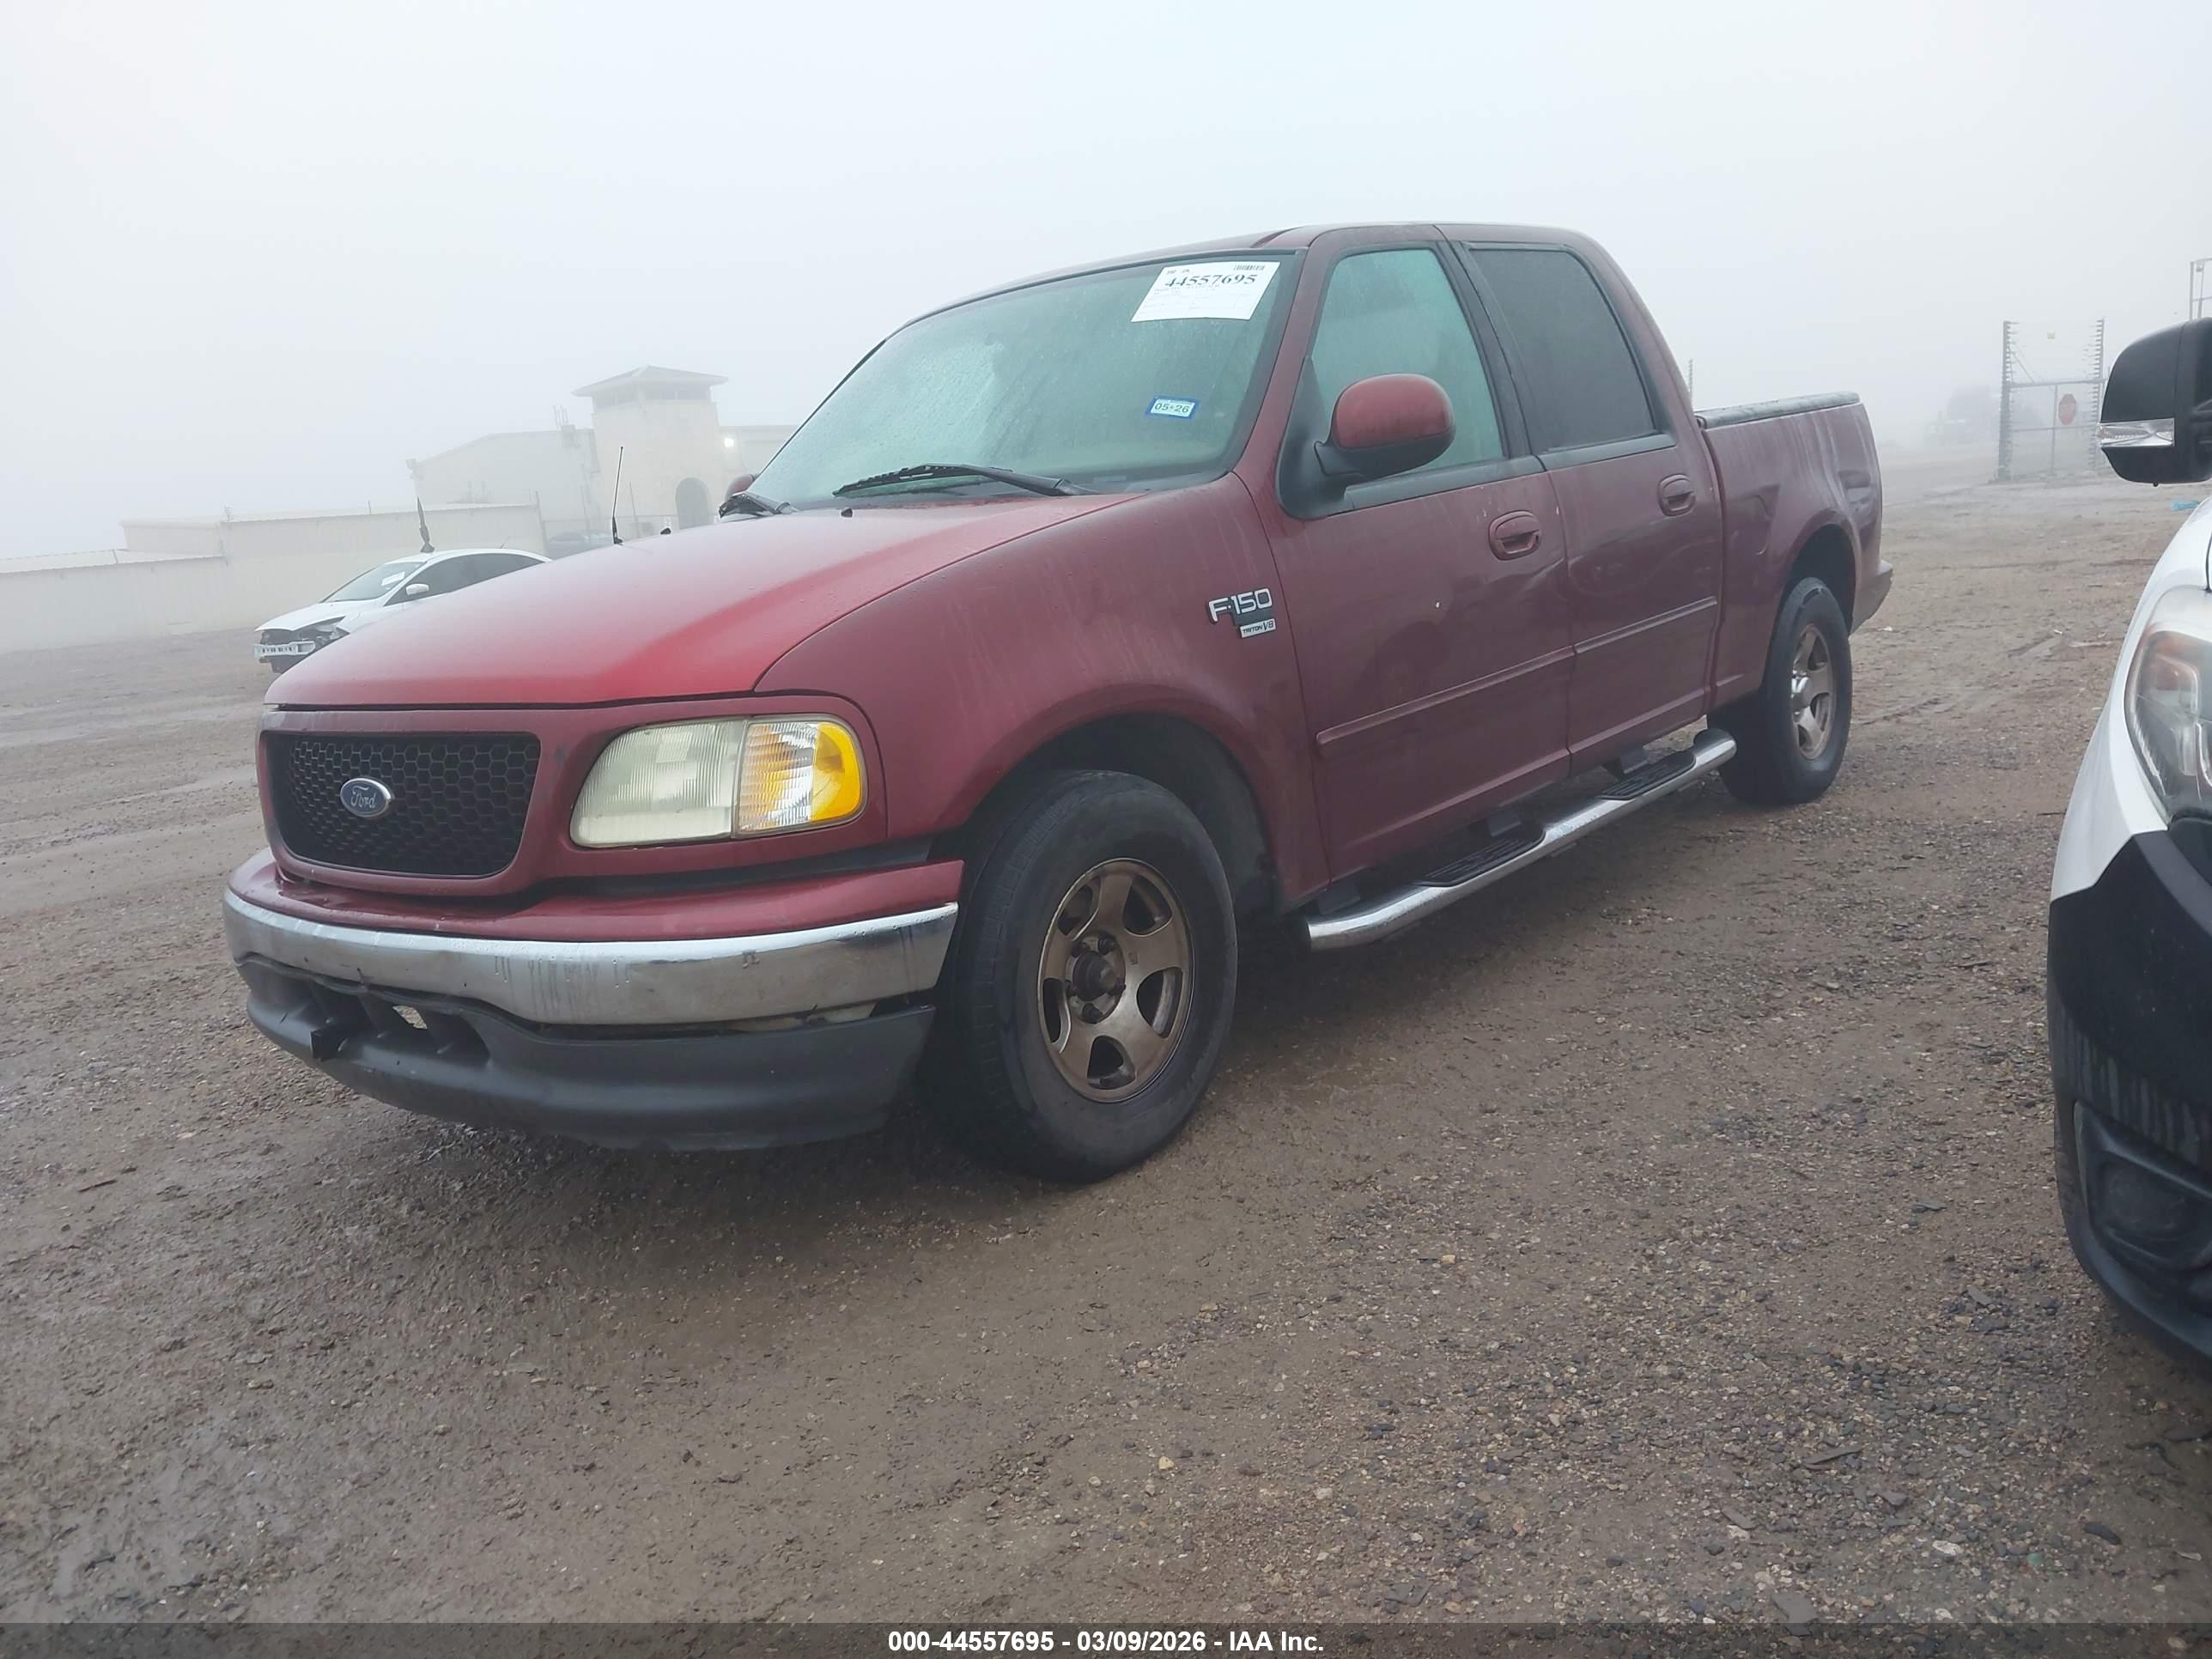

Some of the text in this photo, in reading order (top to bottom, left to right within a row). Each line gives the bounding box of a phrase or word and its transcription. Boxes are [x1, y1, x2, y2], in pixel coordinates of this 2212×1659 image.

[1165, 274, 1258, 287] 44557695
[1262, 620, 1274, 631] V8
[350, 785, 377, 808] Ford
